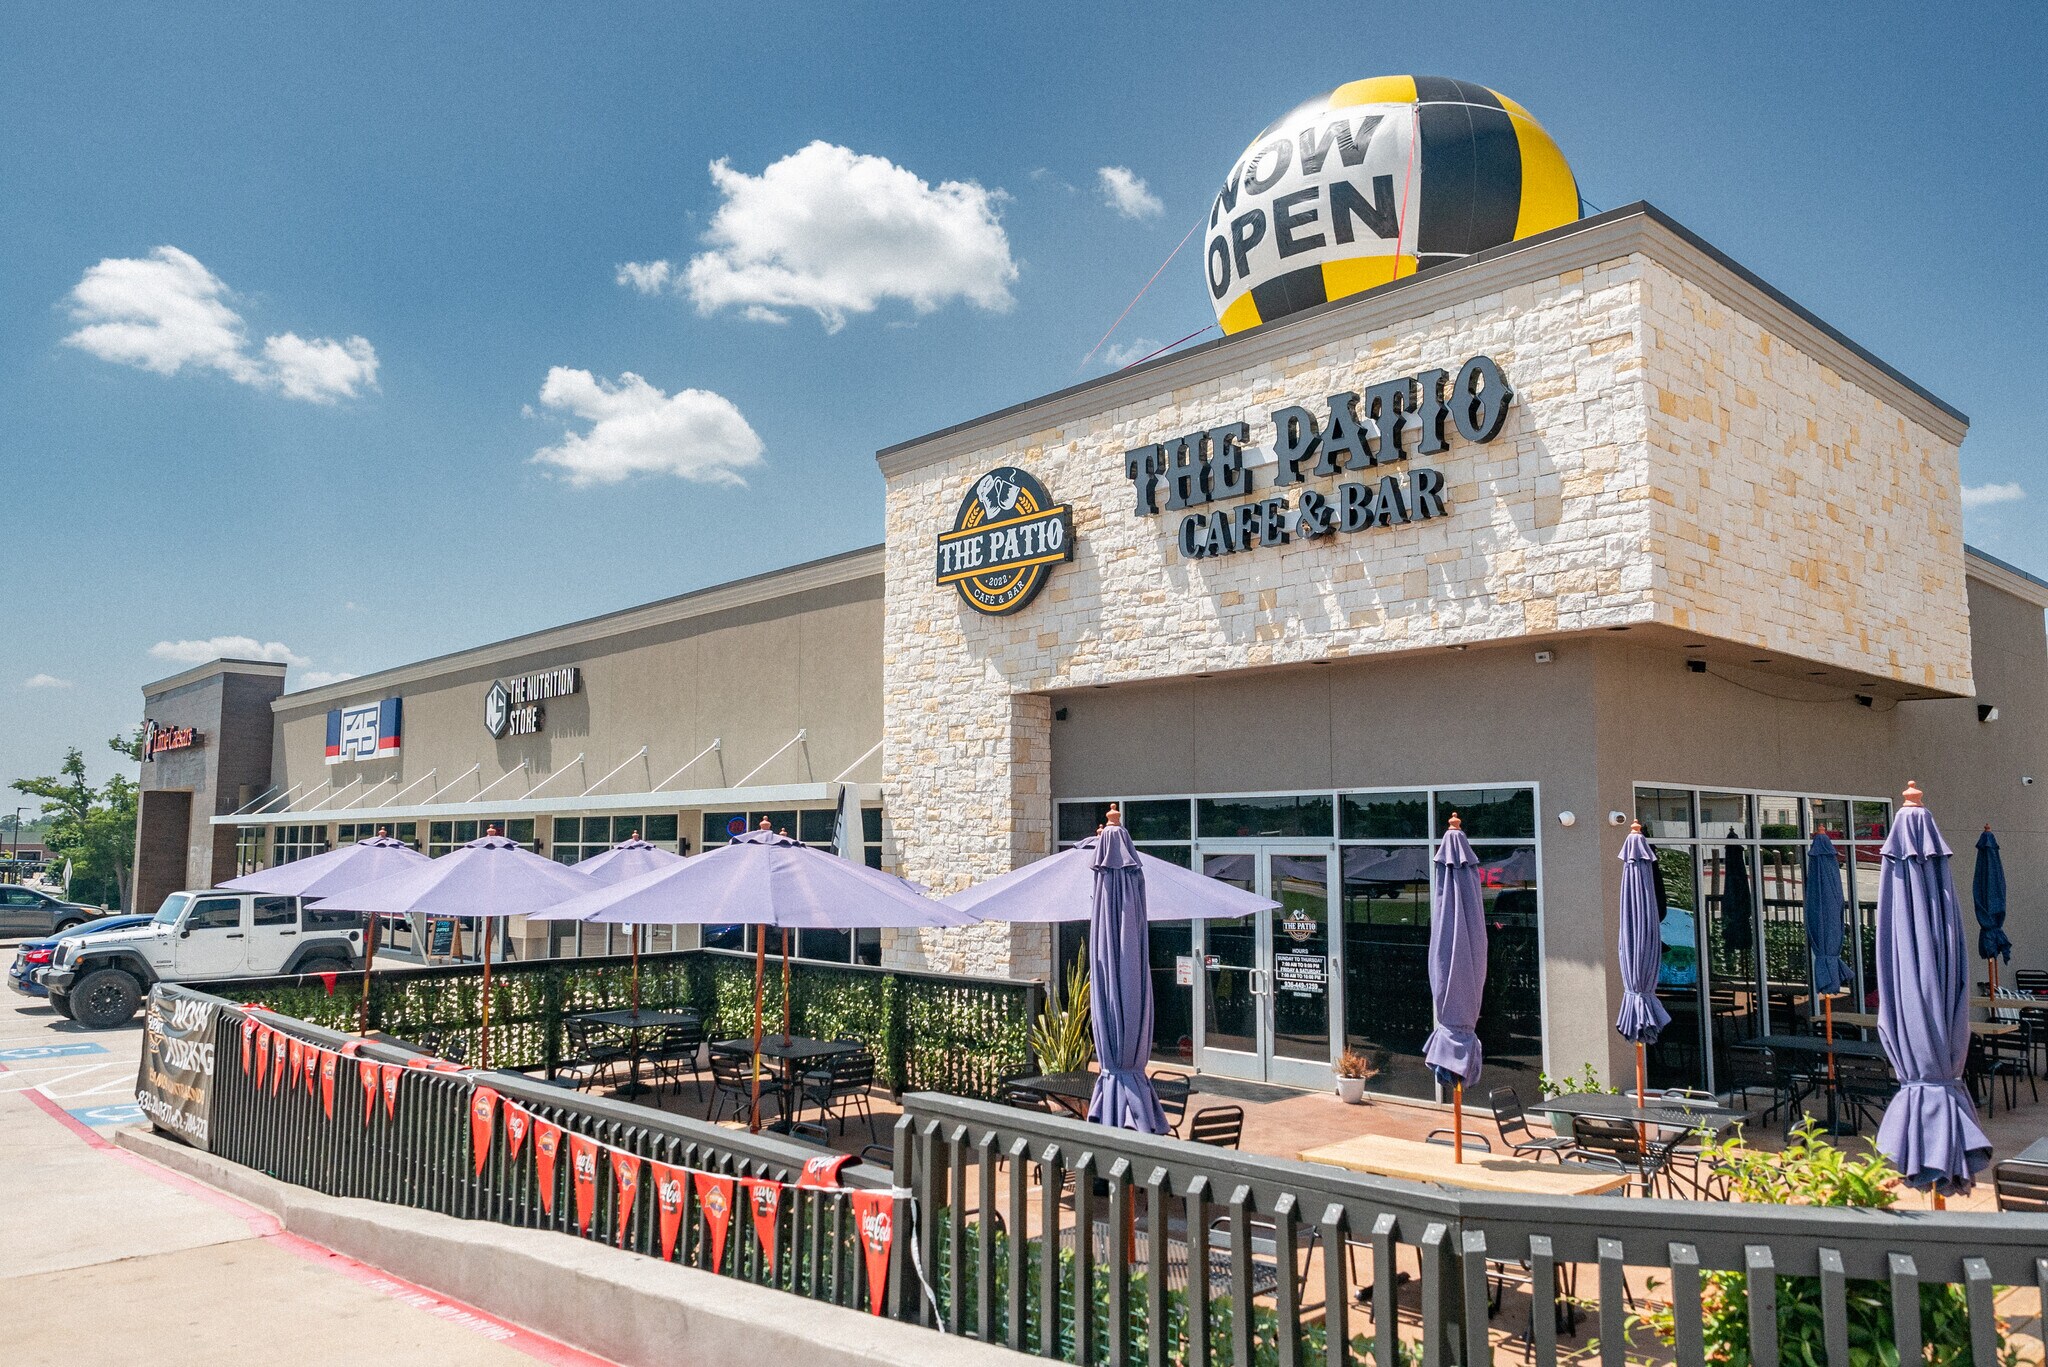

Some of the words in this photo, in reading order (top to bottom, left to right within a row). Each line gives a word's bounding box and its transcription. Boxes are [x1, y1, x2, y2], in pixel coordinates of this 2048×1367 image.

[1211, 115, 1385, 229] NOW
[1208, 174, 1400, 300] OPEN
[1125, 421, 1252, 517] THE
[1271, 355, 1513, 486] PATIO
[1178, 497, 1289, 559] CAFE
[1338, 468, 1448, 533] BAR
[939, 536, 983, 572] THE
[989, 518, 1064, 563] PATIO
[988, 575, 1008, 587] 2022
[998, 596, 1005, 604] &
[1008, 580, 1024, 600] BAR
[511, 678, 526, 704] THE
[526, 668, 576, 702] NUTRITION
[341, 704, 379, 758] F45
[509, 707, 537, 736] STORE
[1284, 922, 1296, 930] THE
[1297, 922, 1316, 931] PATIO
[172, 1000, 215, 1032] NOW
